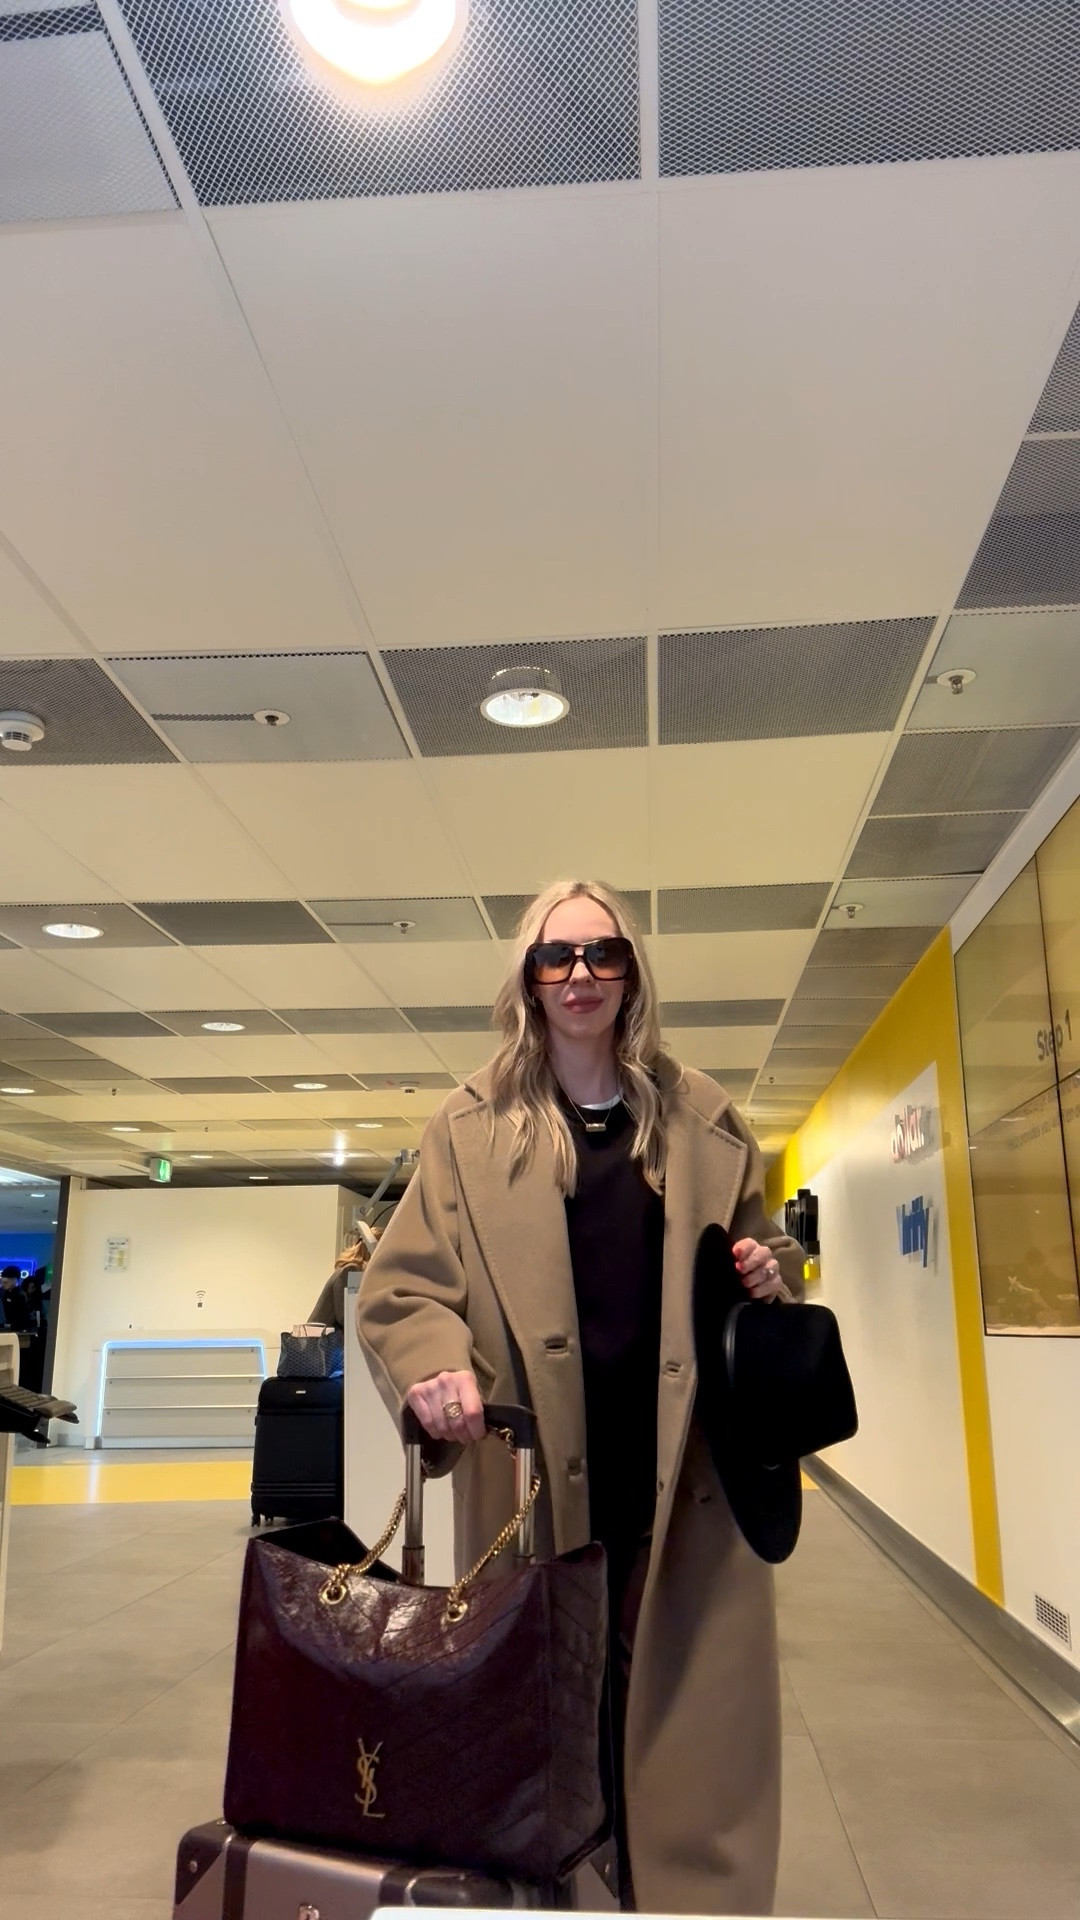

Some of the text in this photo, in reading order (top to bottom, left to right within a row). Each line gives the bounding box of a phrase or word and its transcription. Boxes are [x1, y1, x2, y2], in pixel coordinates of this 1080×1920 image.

[1037, 1008, 1073, 1061] Step 1
[354, 1737, 386, 1818] YSL
